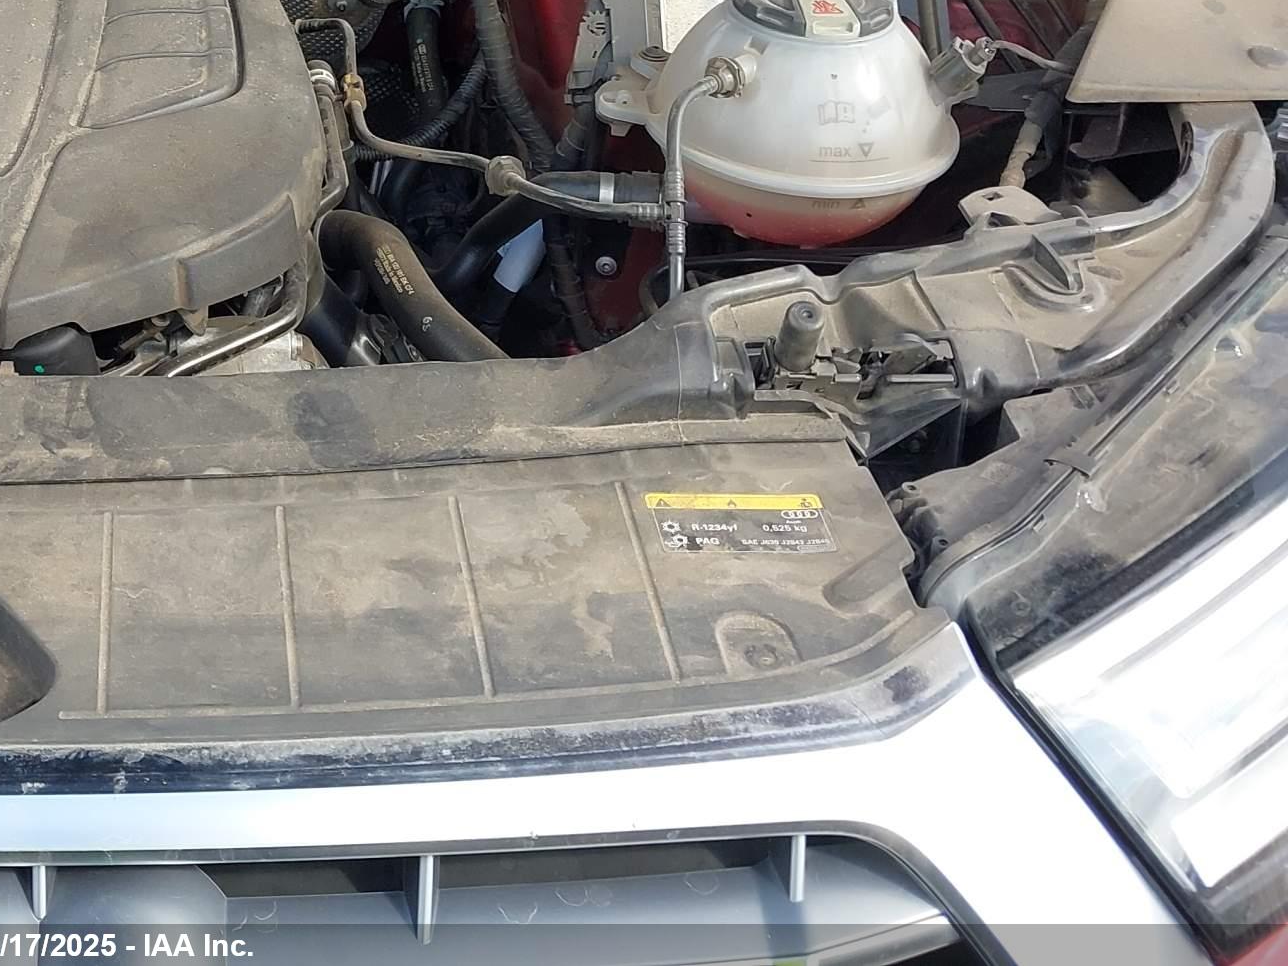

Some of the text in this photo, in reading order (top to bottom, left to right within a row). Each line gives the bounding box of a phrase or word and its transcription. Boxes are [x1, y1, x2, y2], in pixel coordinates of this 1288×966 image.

[818, 145, 852, 158] max
[691, 523, 738, 533] R-1234yf
[794, 525, 808, 533] kg
[695, 537, 721, 545] PAG
